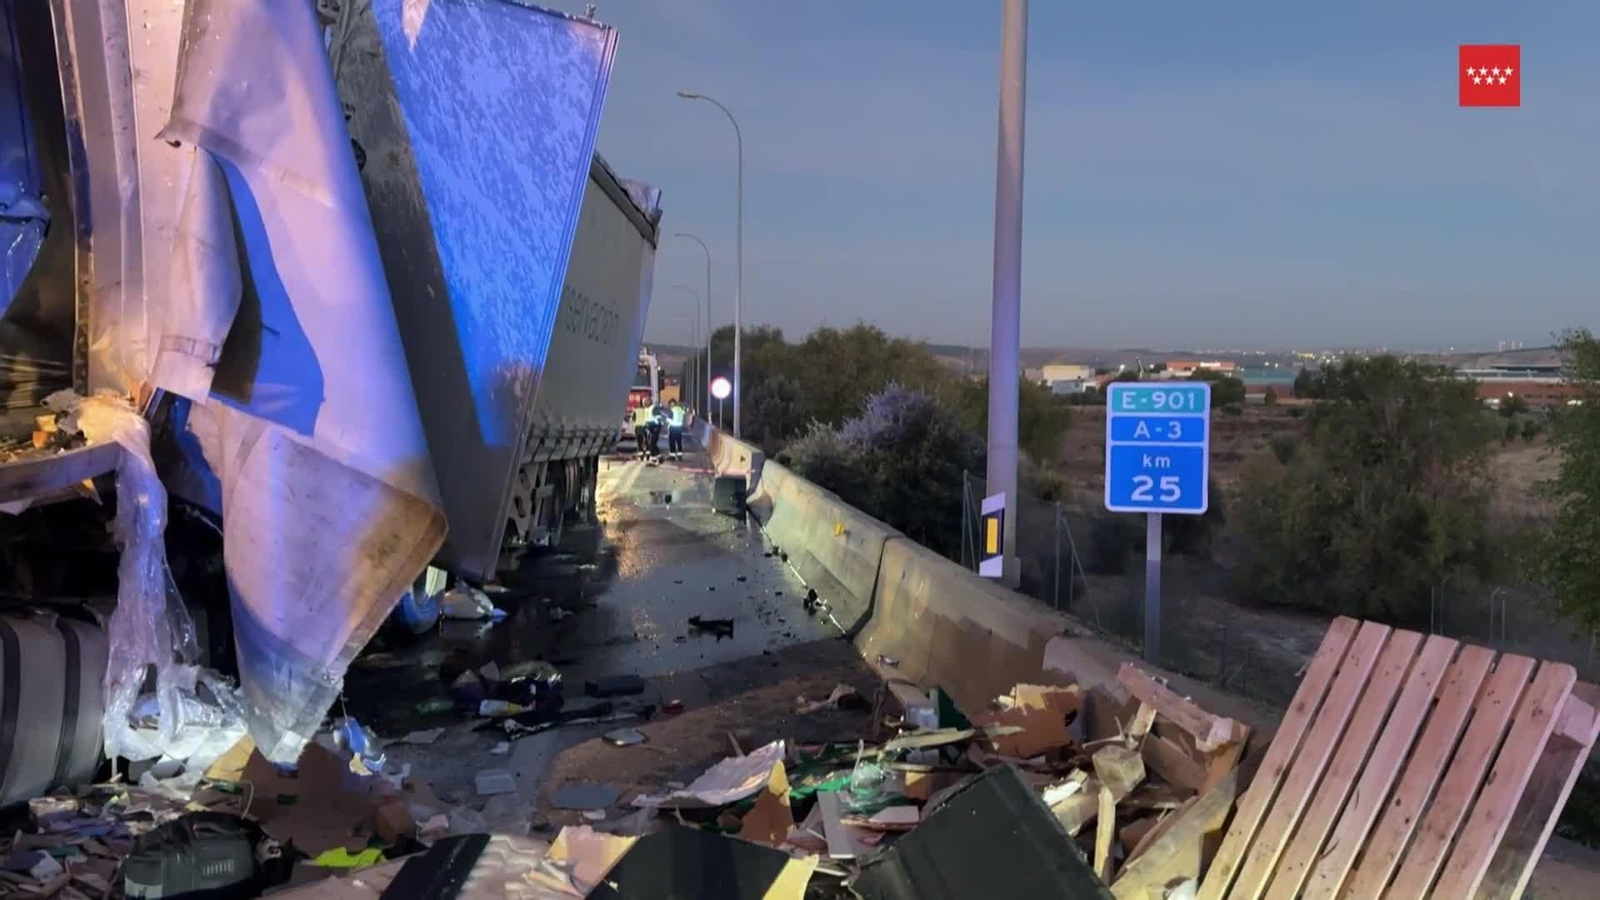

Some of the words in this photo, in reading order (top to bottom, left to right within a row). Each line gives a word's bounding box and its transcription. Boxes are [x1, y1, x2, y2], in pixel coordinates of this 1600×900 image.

[1122, 391, 1194, 410] E-901
[1133, 420, 1182, 439] A-3
[1143, 454, 1170, 468] km
[1131, 475, 1181, 502] 25
